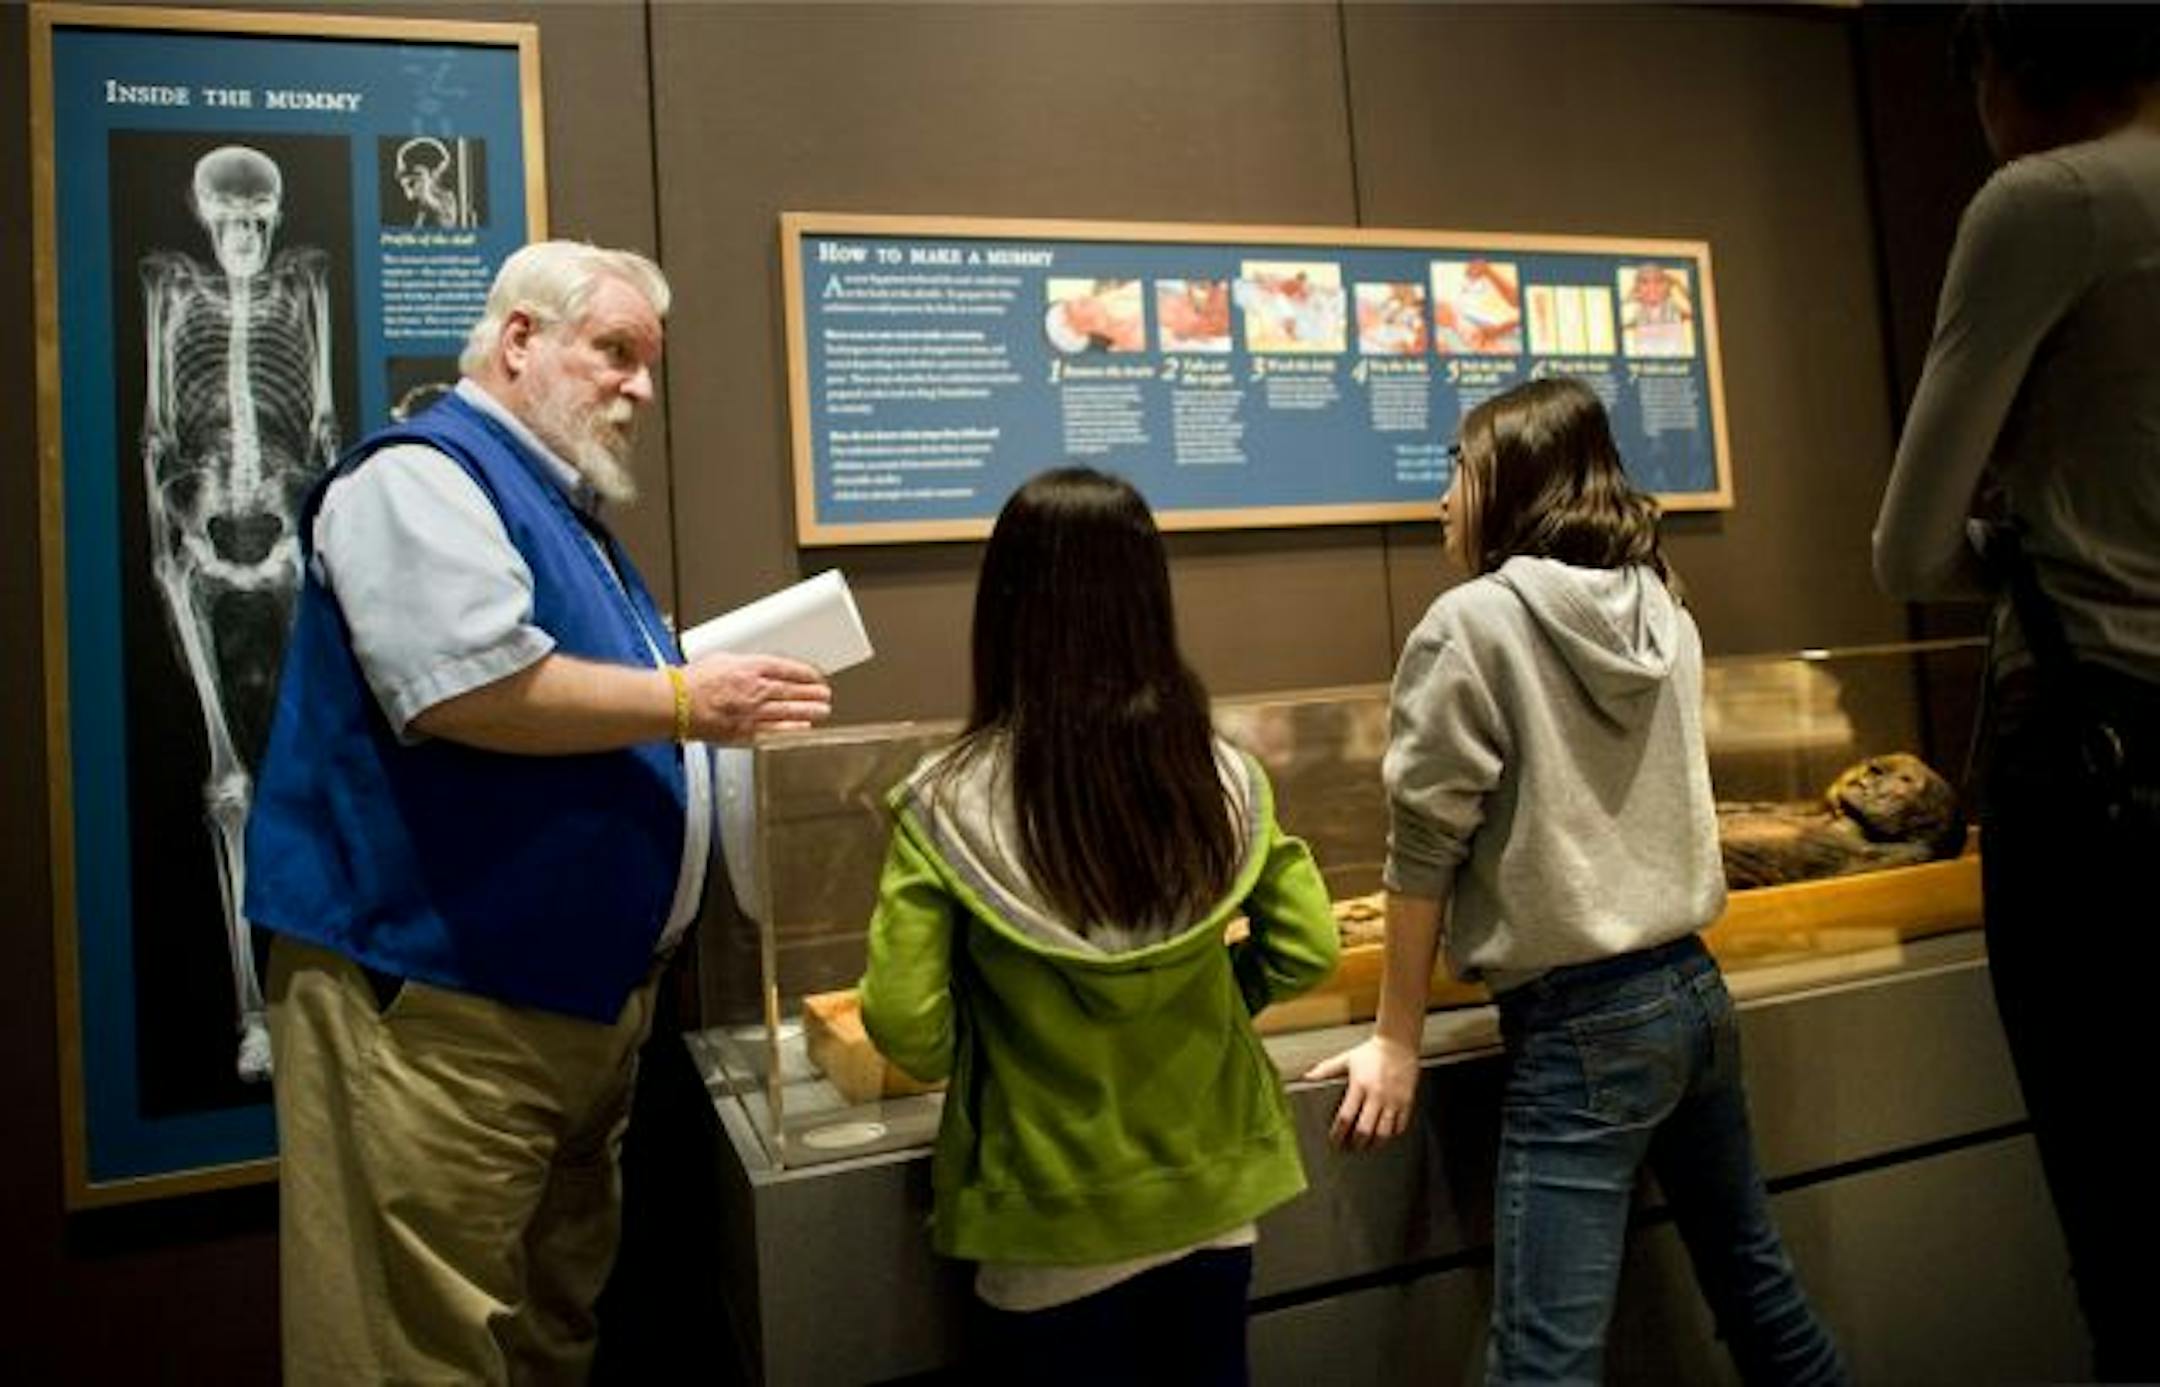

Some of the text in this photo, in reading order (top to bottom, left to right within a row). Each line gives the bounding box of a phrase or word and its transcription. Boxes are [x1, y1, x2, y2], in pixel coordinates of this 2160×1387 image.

[106, 79, 363, 112] INSIDE THE MUMMY
[876, 248, 903, 264] TO
[910, 249, 964, 266] MAKE
[967, 250, 981, 265] A
[987, 250, 1054, 268] MUMMY
[1159, 357, 1180, 381] 2
